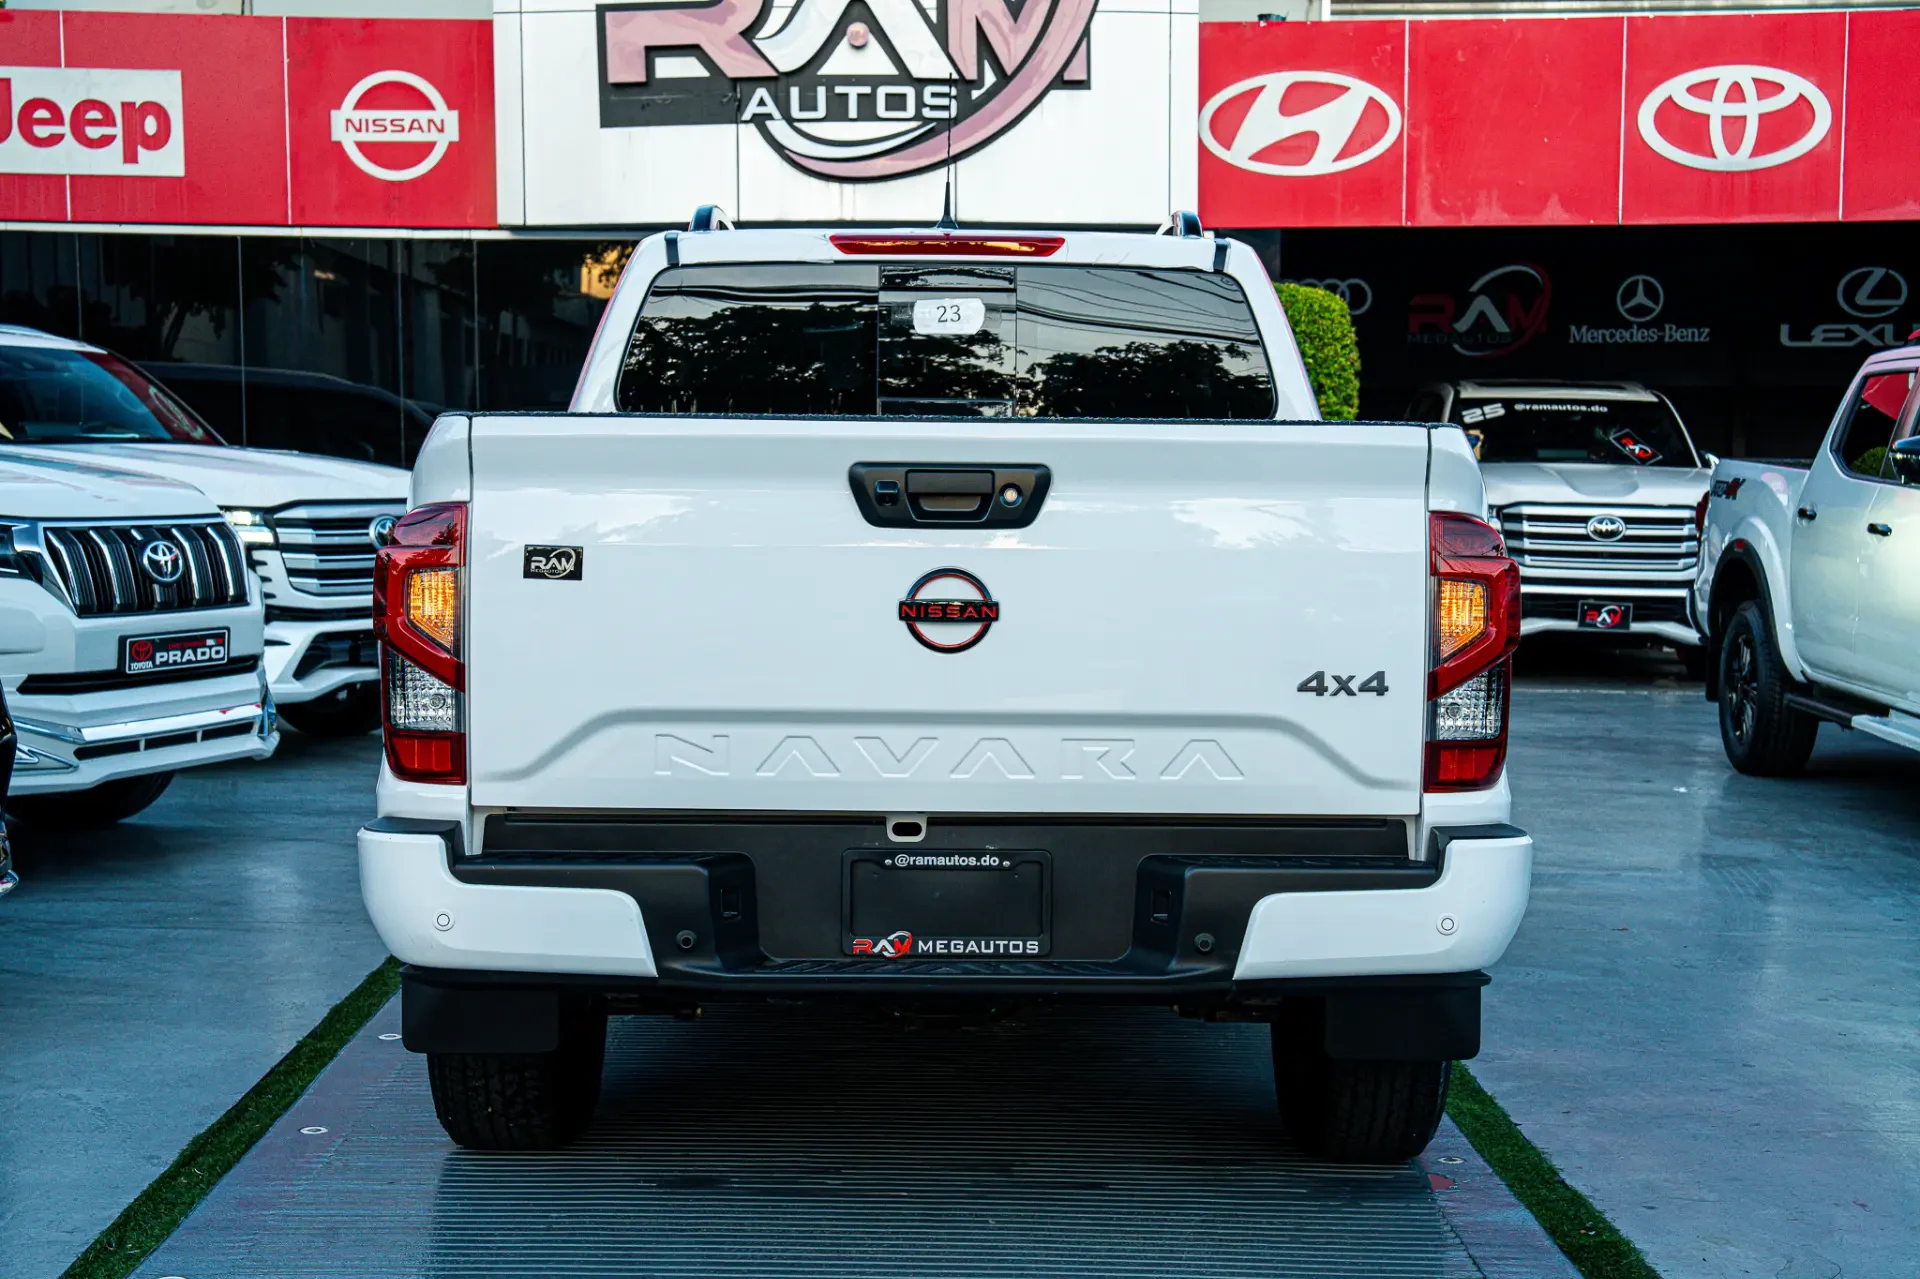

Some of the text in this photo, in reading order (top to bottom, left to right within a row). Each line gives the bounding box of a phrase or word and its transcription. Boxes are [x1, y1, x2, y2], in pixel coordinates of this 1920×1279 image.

[741, 85, 958, 121] AUTOS
[345, 118, 445, 133] NISSAN
[936, 304, 961, 323] 23
[1408, 292, 1548, 334] RAM
[1568, 324, 1710, 344] Mercedes-Benz
[1461, 402, 1506, 424] 25
[1513, 403, 1608, 413] @ramautos.do
[530, 555, 575, 571] RAM
[901, 604, 997, 618] NISSAN
[155, 646, 225, 665] PRADO
[130, 660, 154, 671] TOYOTA
[1297, 670, 1389, 697] 4x4
[654, 733, 1245, 780] NAVARA
[894, 854, 1000, 867] @ramautos.do
[852, 937, 1039, 955] RAM MEGAUTOS
